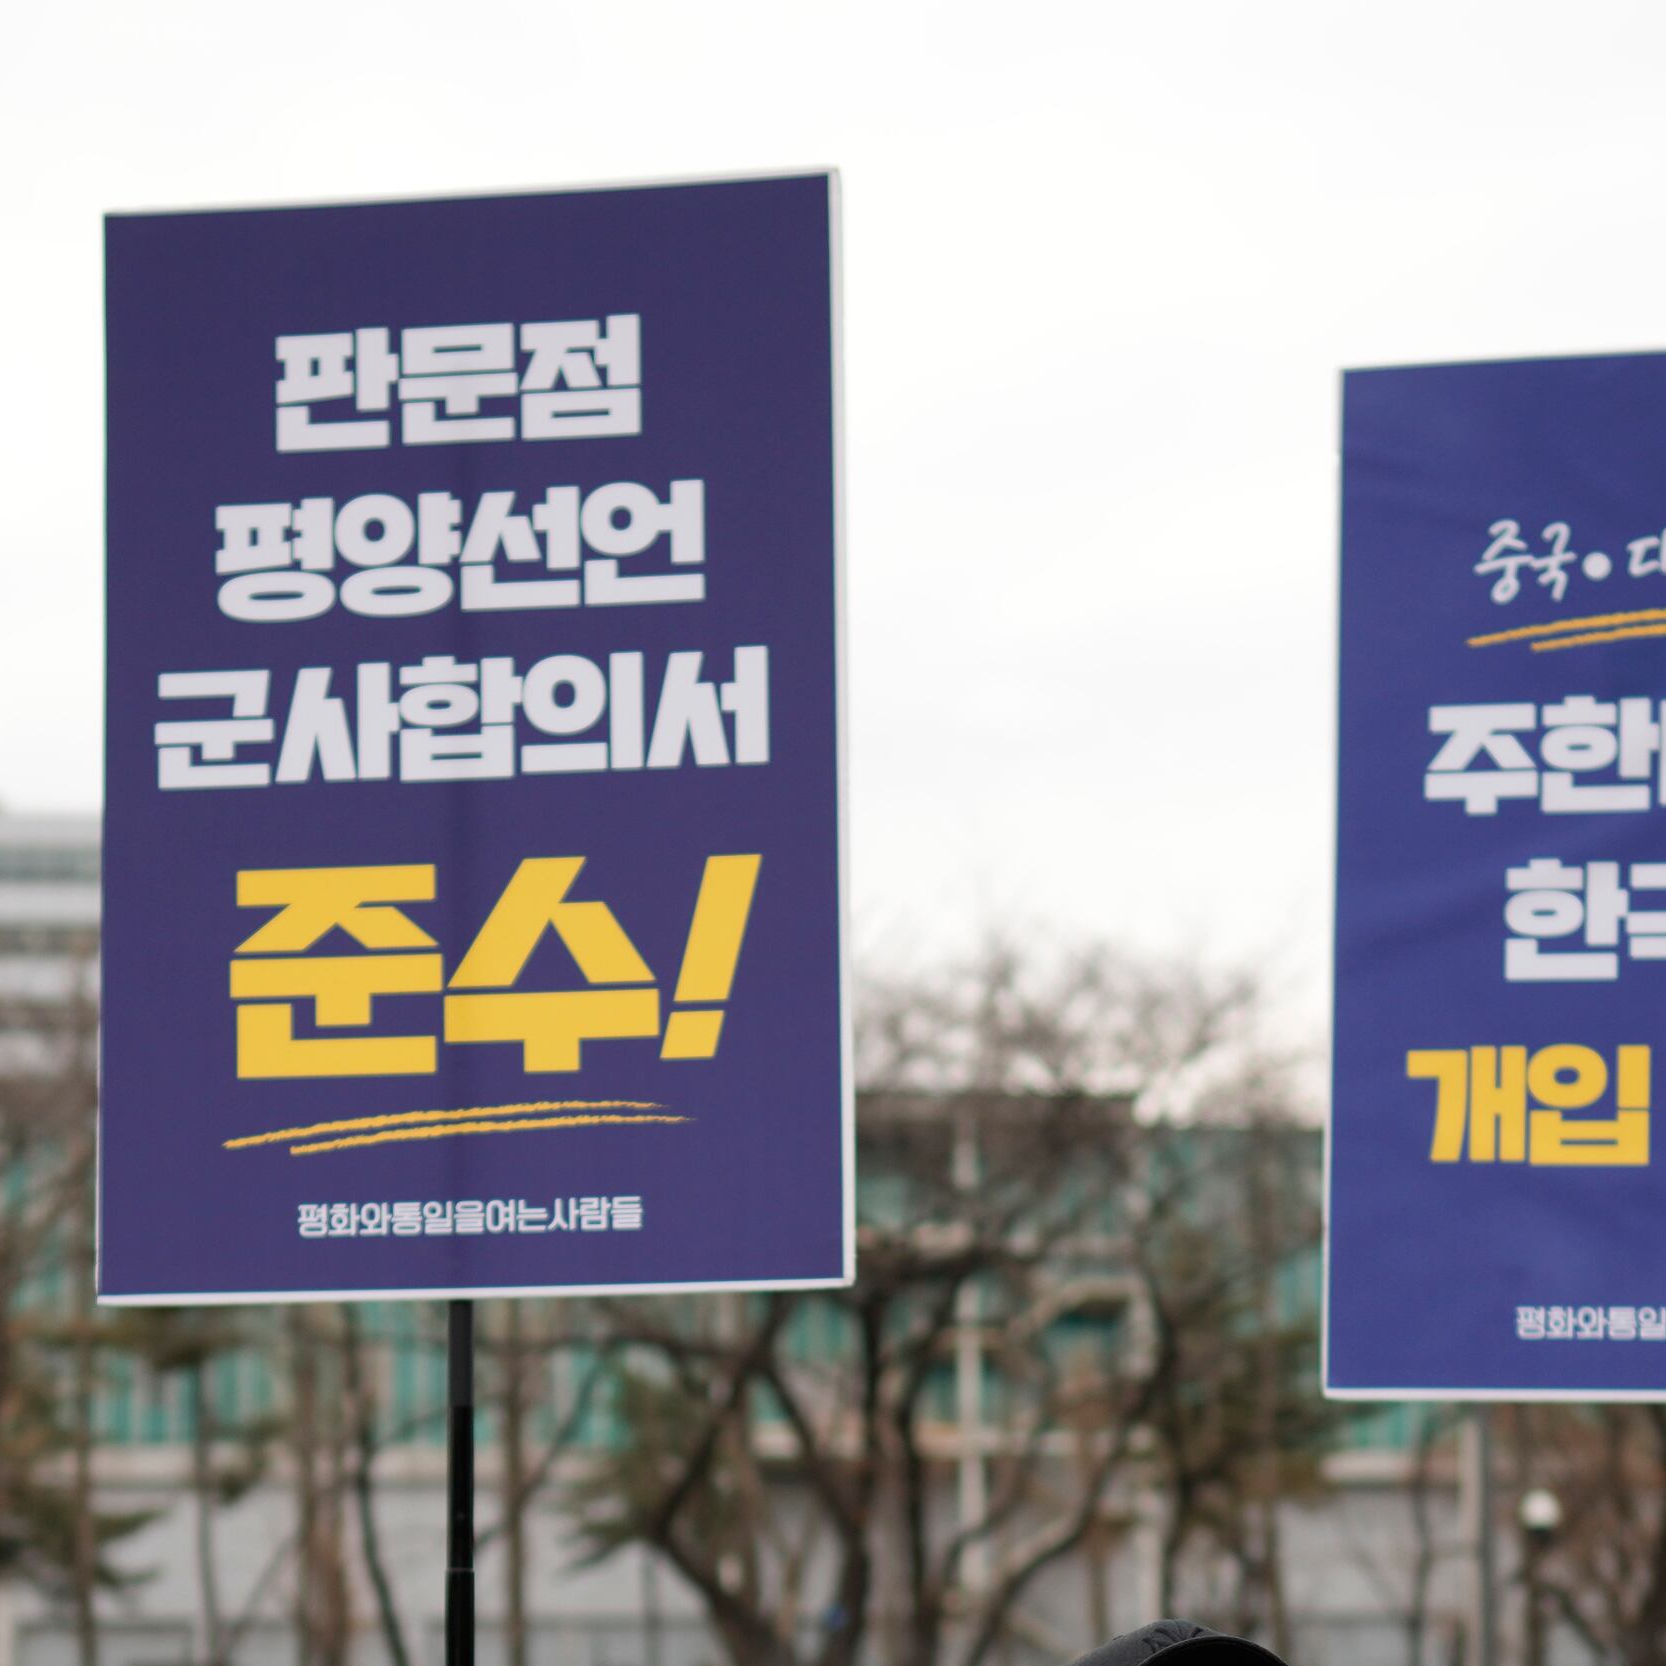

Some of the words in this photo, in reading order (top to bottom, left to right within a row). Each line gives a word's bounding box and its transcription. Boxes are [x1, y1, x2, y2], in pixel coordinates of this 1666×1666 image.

[276, 314, 641, 452] 판문점
[216, 480, 705, 621] 평양선언
[155, 646, 769, 789] 군사합의서
[230, 854, 761, 1079] 준수!
[1407, 1044, 1650, 1165] 개입
[298, 1196, 643, 1237] 평화와통일을여는사람들
